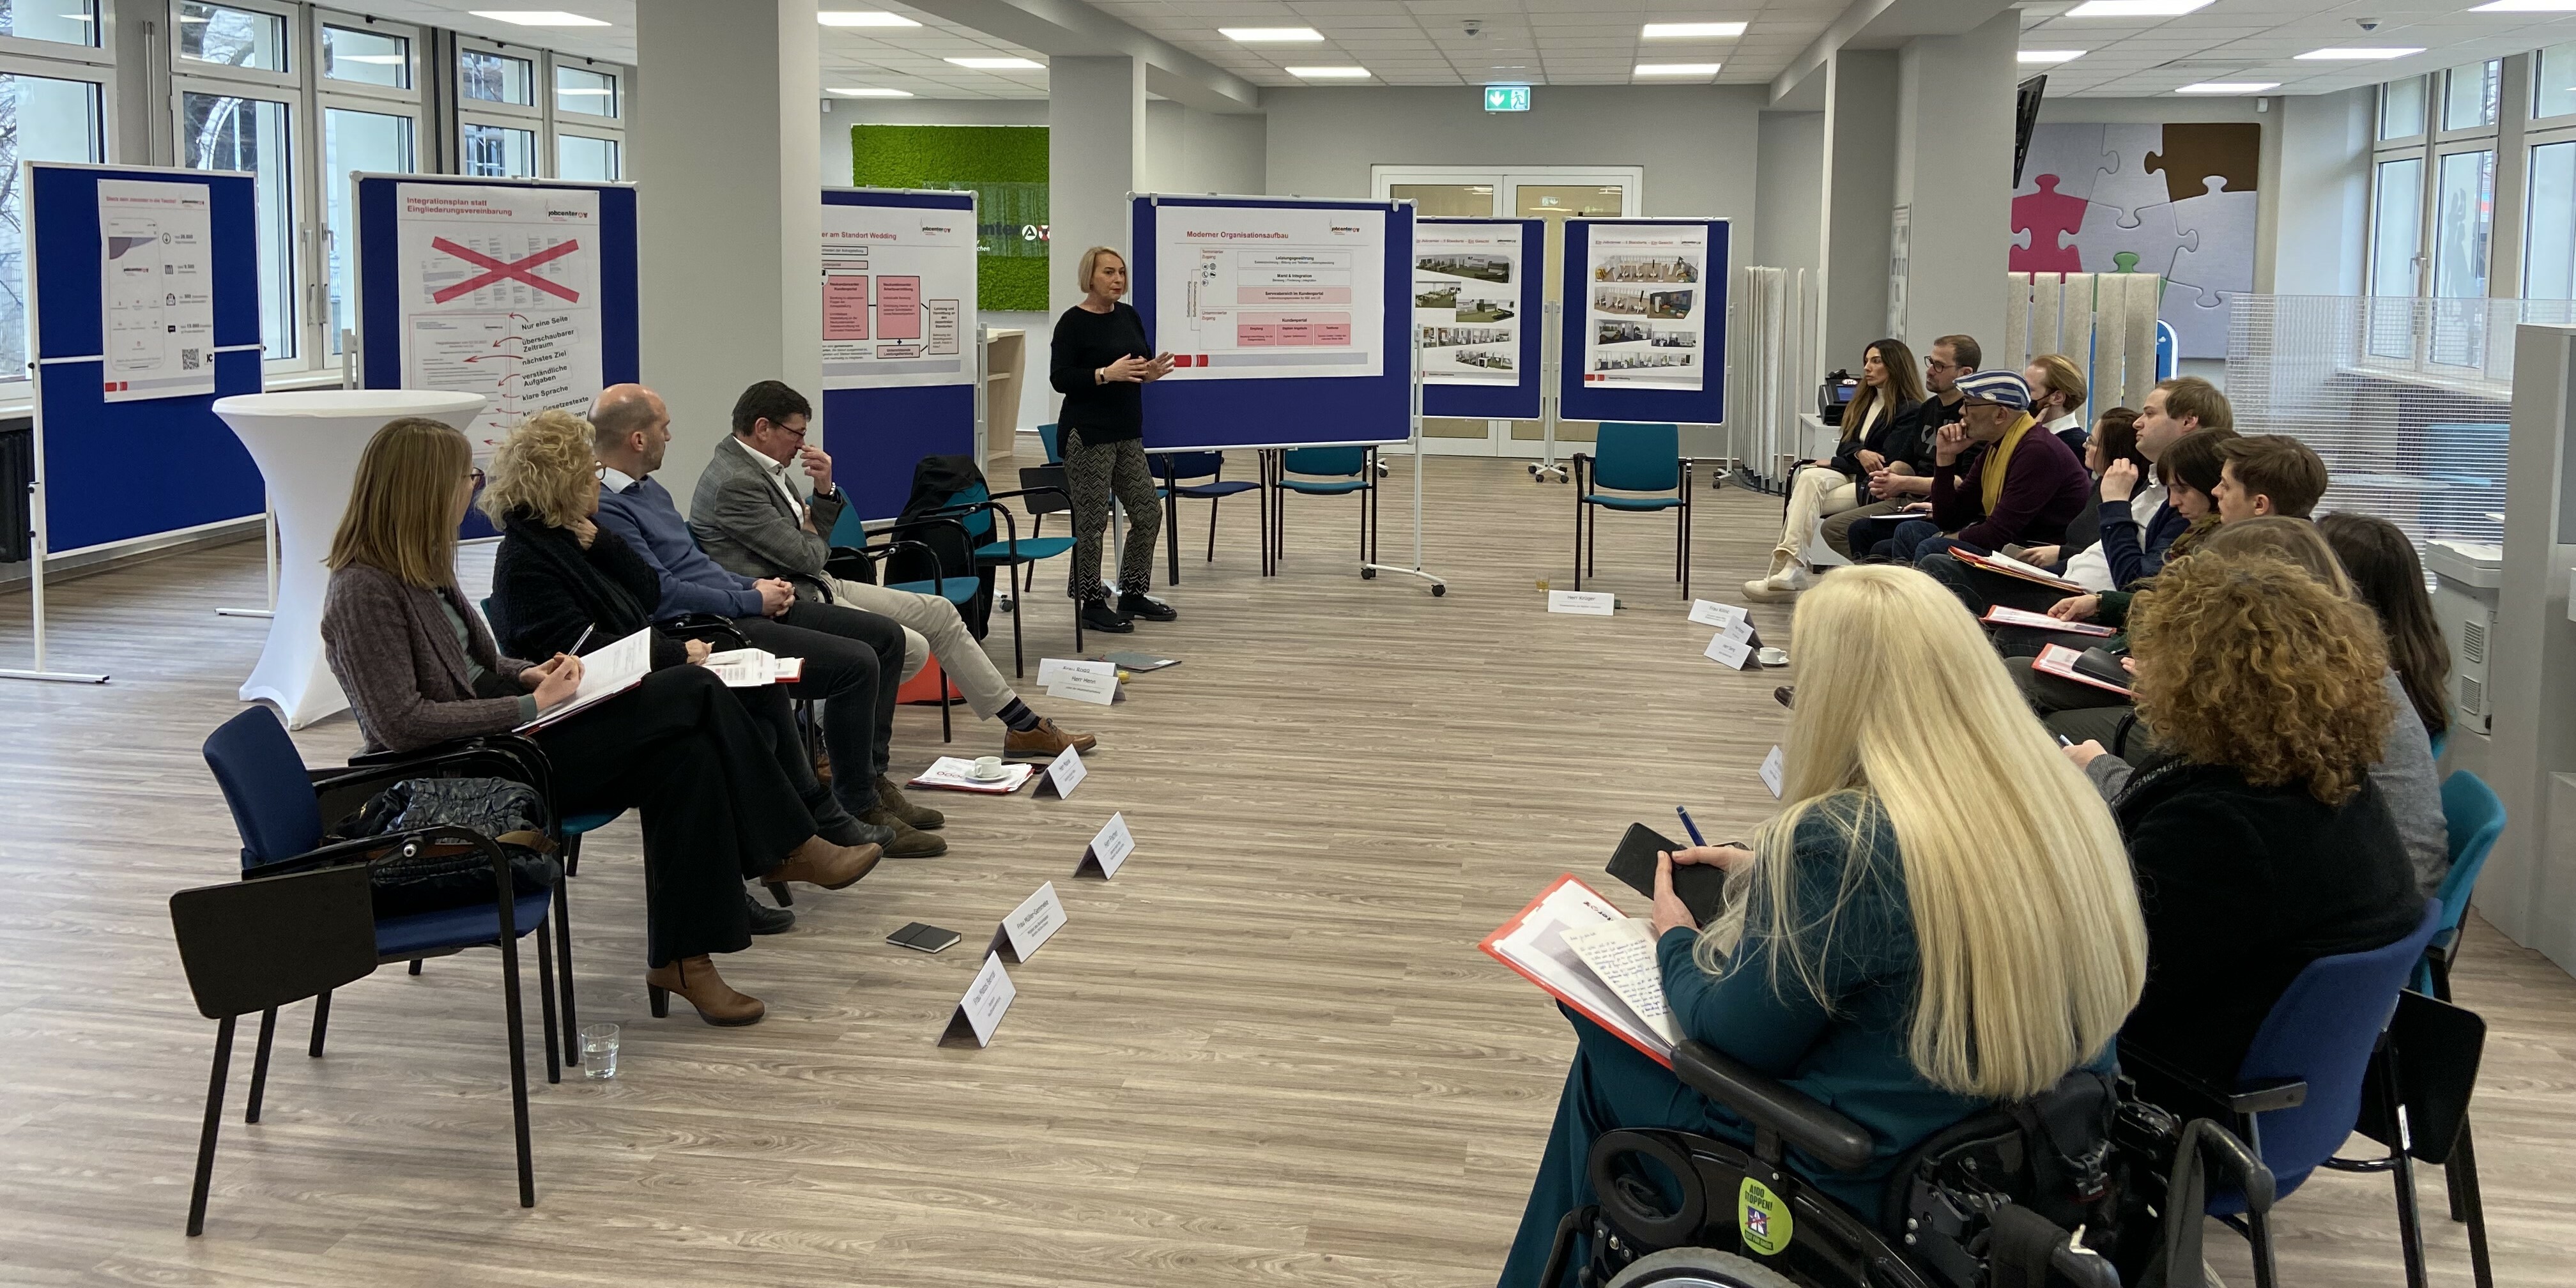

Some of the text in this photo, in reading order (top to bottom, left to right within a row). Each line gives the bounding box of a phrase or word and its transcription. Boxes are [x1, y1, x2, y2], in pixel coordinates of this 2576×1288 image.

[407, 197, 468, 206] Integrationsplan
[407, 205, 512, 216] Eingliederungsvereinbarung
[1220, 231, 1289, 240] Organisationsaufbau
[522, 330, 574, 345] überschaubarer
[523, 342, 553, 353] Zeitraum
[522, 350, 567, 365] nächstes Ziel
[522, 365, 567, 379] verständliche
[524, 375, 556, 387] Aufgaben
[522, 386, 569, 401] klare Sprache
